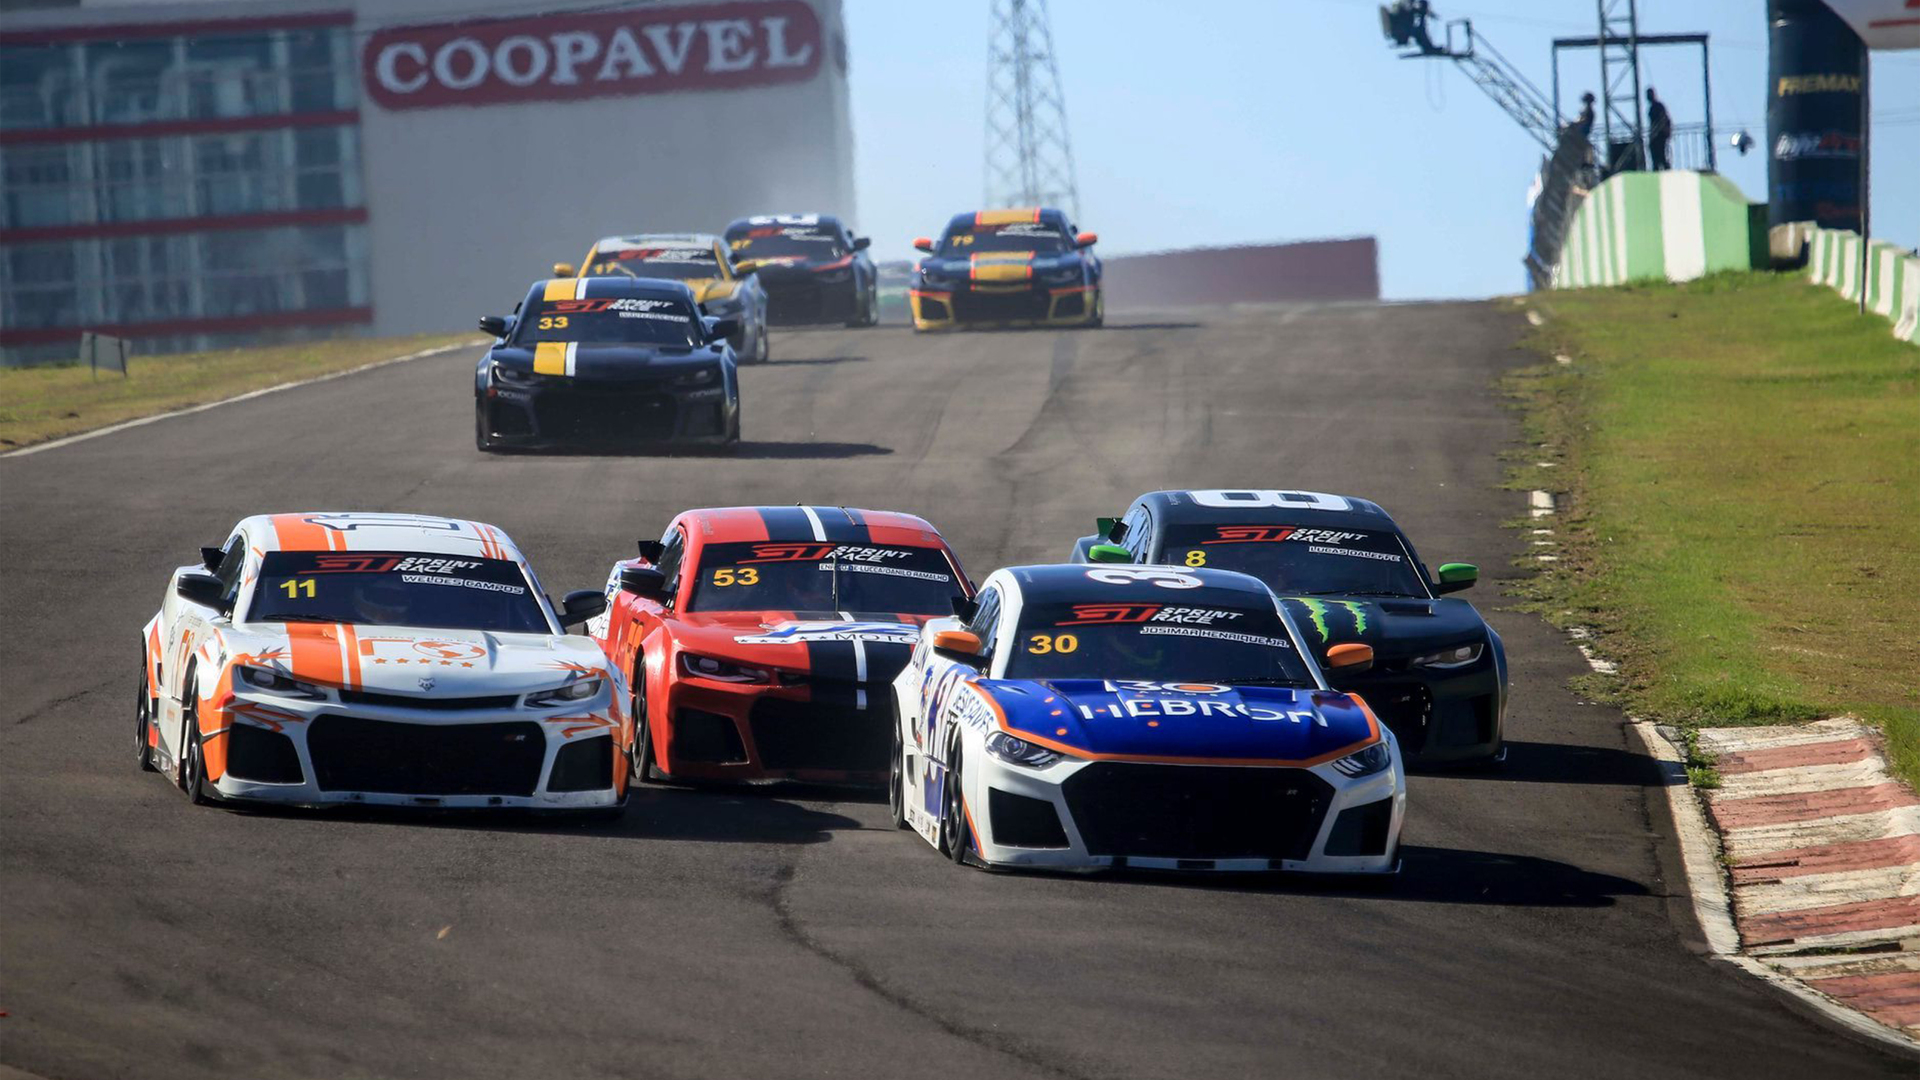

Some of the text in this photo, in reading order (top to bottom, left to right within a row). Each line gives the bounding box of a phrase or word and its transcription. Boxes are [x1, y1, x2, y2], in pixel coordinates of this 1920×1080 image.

[375, 17, 814, 93] COOPAVEL
[538, 316, 569, 330] 33
[1286, 533, 1341, 545] RACE
[1295, 527, 1369, 541] SPRINT
[825, 551, 883, 563] RACE
[833, 545, 914, 559] SPRINT
[1308, 545, 1348, 556] LUCAS
[402, 556, 483, 570] SPRINT
[1185, 550, 1207, 567] 8
[393, 563, 454, 575] RACE
[401, 574, 463, 587] WELDES
[712, 567, 760, 588] 53
[280, 579, 316, 599] 11
[1151, 614, 1213, 625] RACE
[1161, 607, 1244, 620] SPRINT
[1139, 626, 1200, 637] JOSIMAR
[1028, 634, 1079, 654] 30
[1078, 699, 1329, 728] HEBRON
